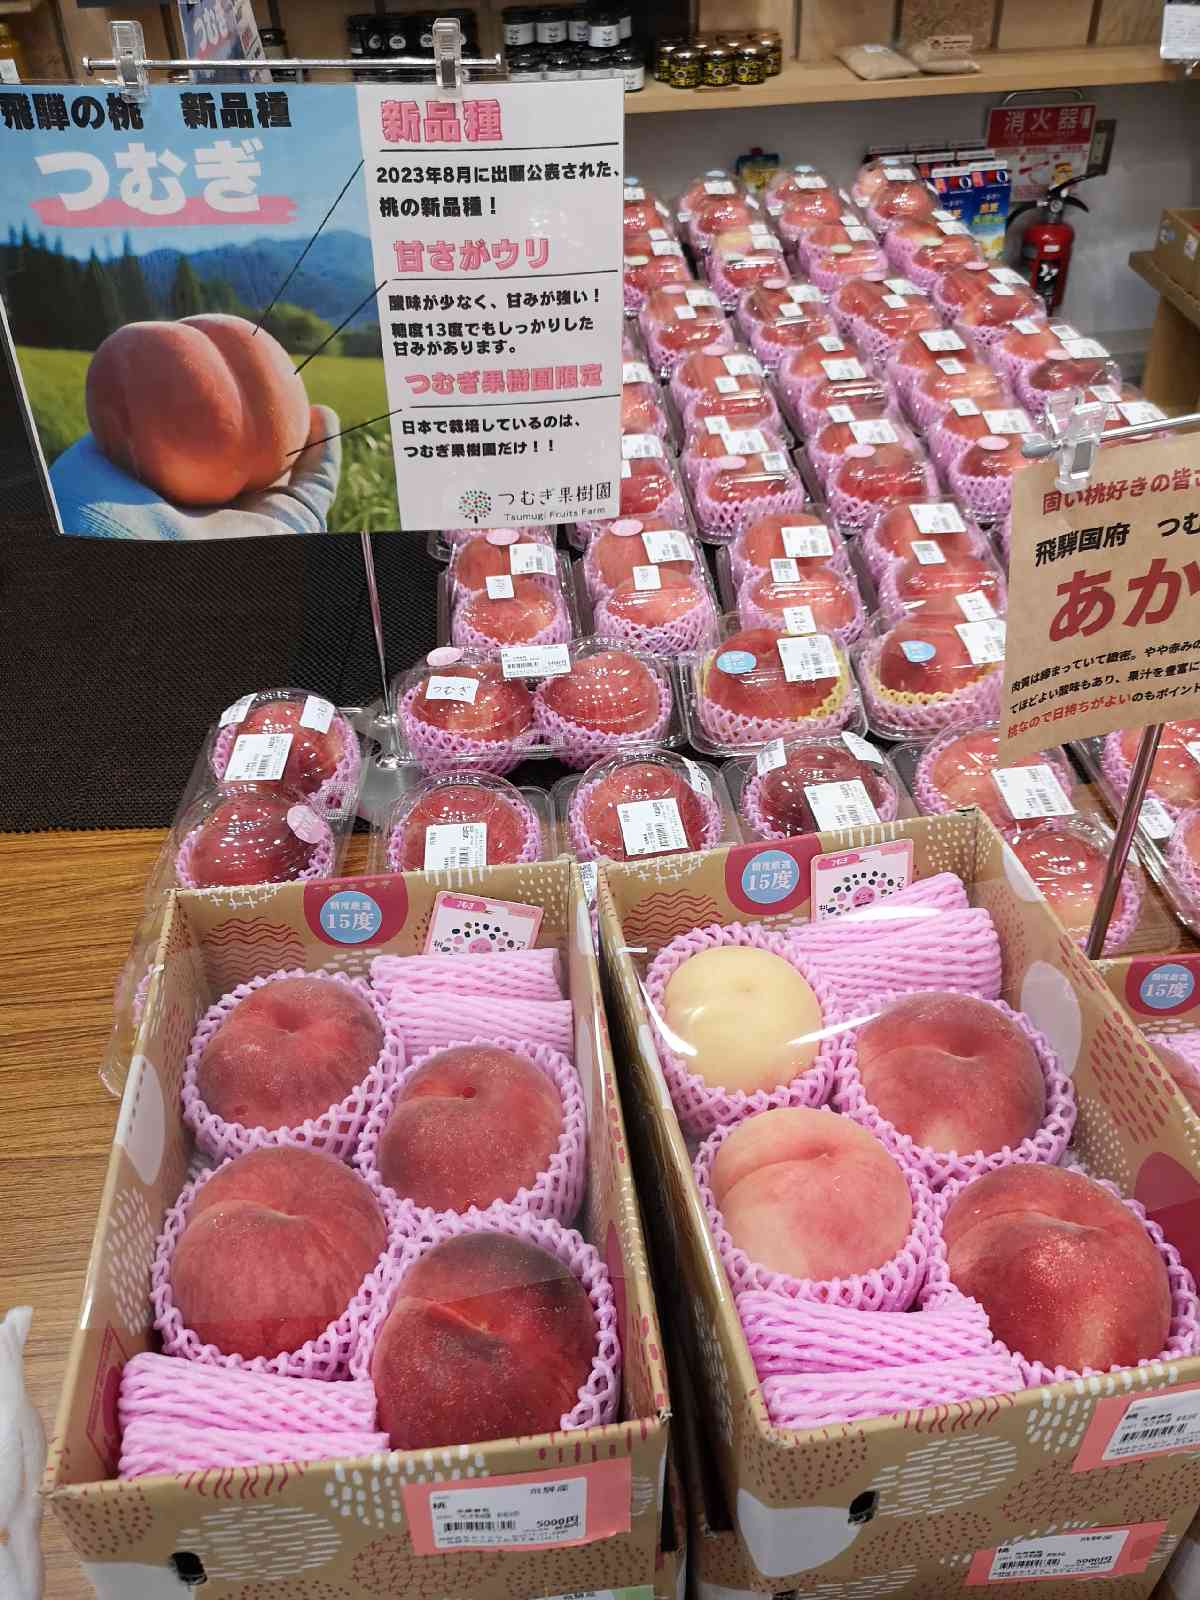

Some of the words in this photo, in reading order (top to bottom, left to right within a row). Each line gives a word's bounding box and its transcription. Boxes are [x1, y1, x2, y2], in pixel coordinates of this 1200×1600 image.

[181, 91, 292, 128] 新品種
[381, 99, 503, 142] 新品種
[1006, 108, 1079, 137] 消火器
[34, 137, 265, 216] つむぎ
[376, 160, 619, 184] 2023年8月に出願公表された、
[379, 196, 497, 217] 桃の新品種！
[393, 238, 550, 272] 甘さがウリ
[391, 315, 595, 338] 糖度13度でもしっかりした
[392, 340, 517, 357] 甘みがあります。
[404, 362, 603, 395] つむぎ果樹園限定
[402, 414, 581, 435] 日本で栽培しているのは、
[403, 439, 554, 459] つむぎ果樹園だけ！！
[498, 481, 611, 506] つむぎ果樹園
[504, 512, 547, 521] Tsumugi
[549, 508, 579, 519] Fruits
[581, 505, 606, 516] Farm
[1035, 521, 1131, 568] 飛騨国府
[748, 871, 793, 891] 15度
[327, 912, 375, 932] 15度
[1144, 982, 1190, 999] 15度
